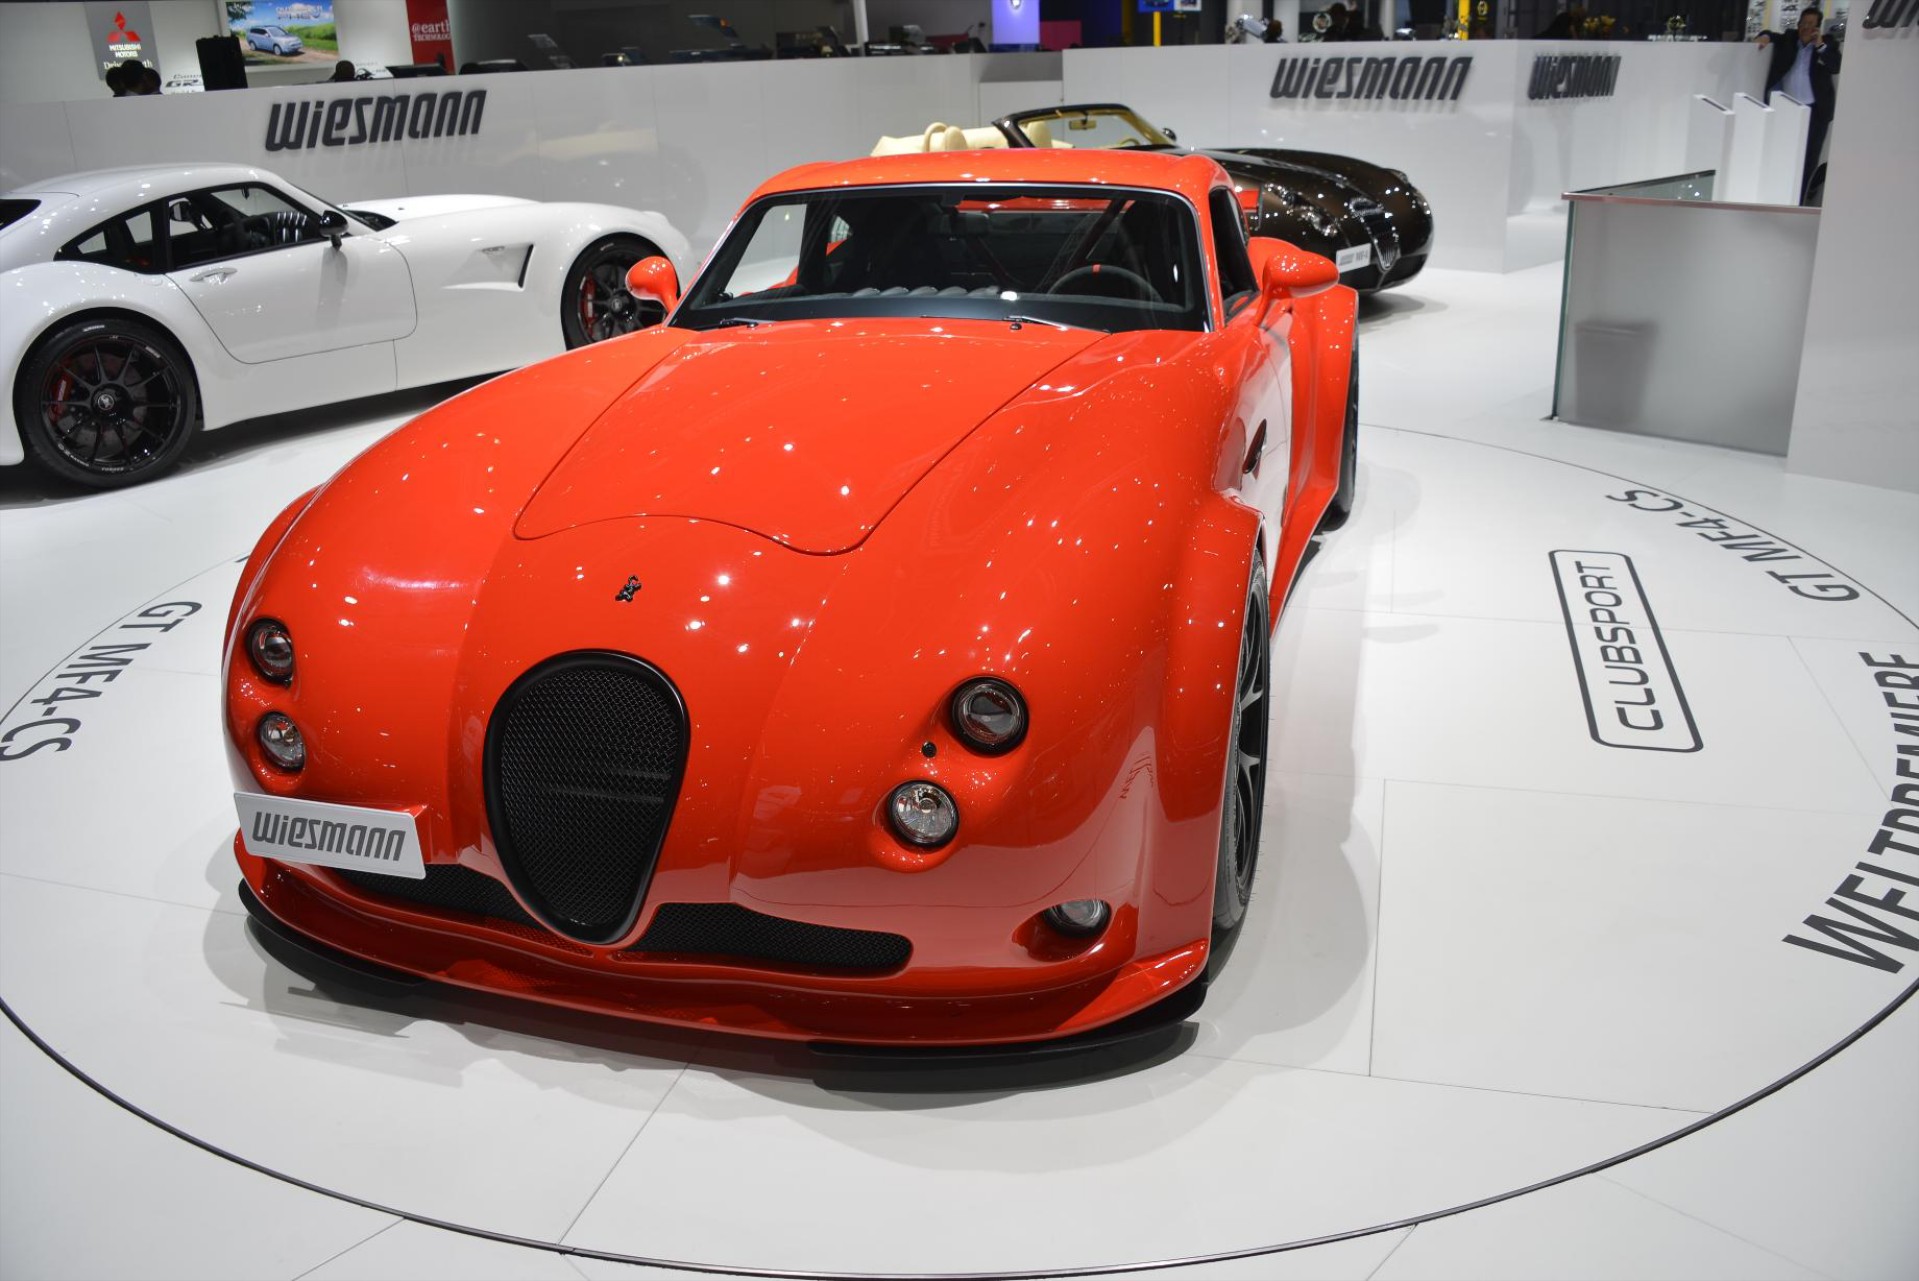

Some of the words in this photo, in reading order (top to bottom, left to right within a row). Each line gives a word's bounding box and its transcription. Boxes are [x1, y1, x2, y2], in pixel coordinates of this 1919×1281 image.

[413, 33, 451, 42] TECHNOLOG
[1604, 489, 1803, 562] MF4-CS
[1765, 570, 1860, 602] GT
[118, 601, 203, 632] GT
[1574, 560, 1664, 731] CLUBSPORT
[0, 642, 152, 762] MF4-CS
